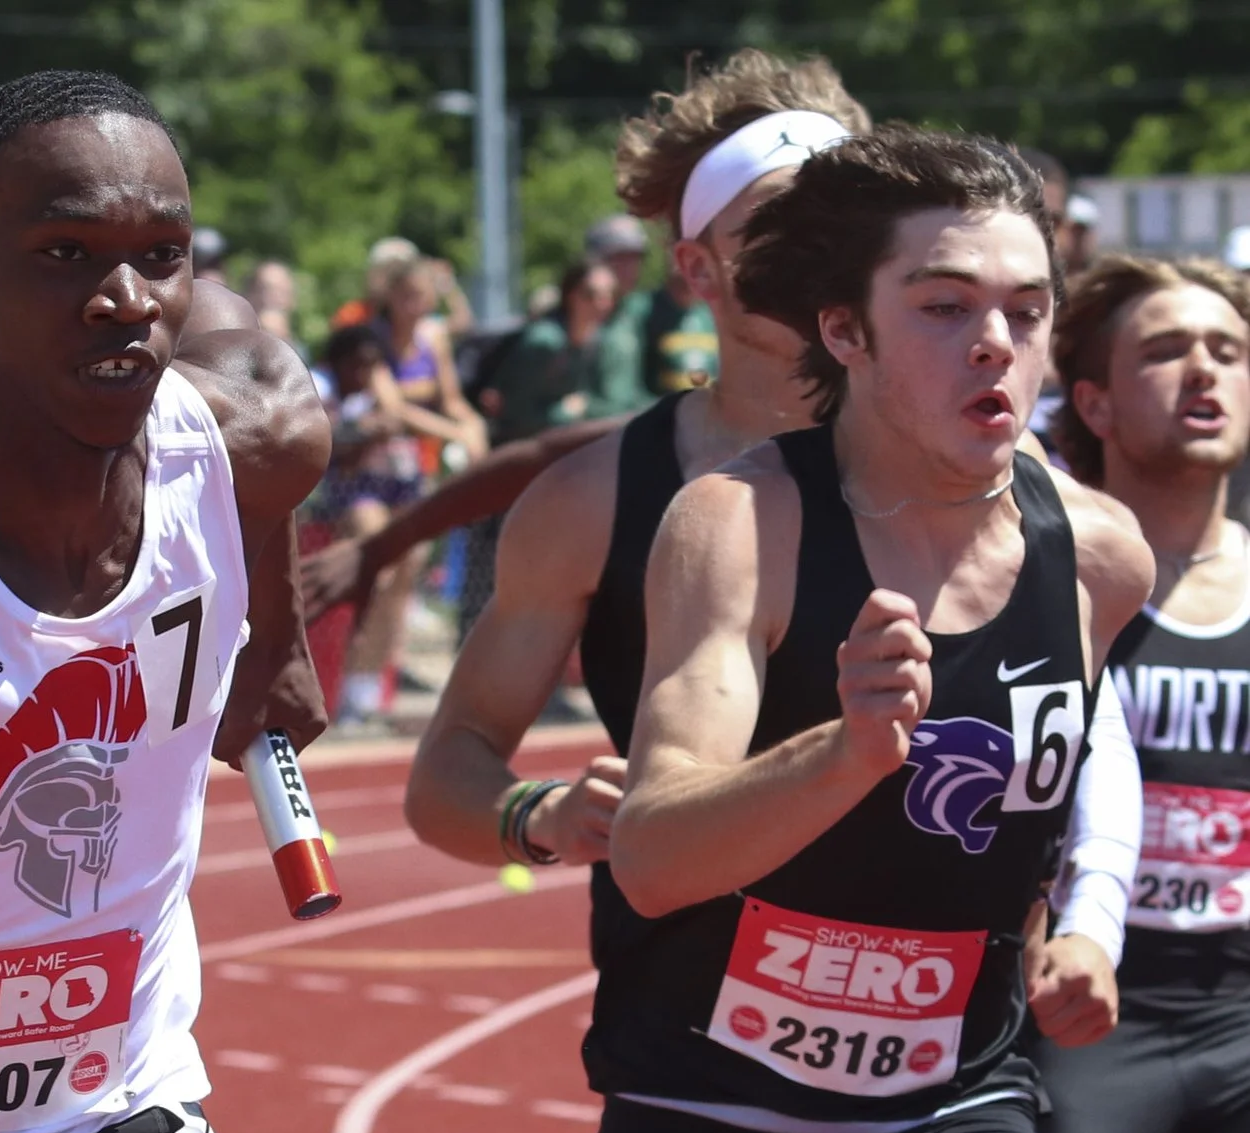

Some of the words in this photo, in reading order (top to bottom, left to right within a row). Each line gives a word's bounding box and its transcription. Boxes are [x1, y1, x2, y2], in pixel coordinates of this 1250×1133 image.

[151, 595, 203, 731] 7
[1025, 690, 1068, 803] 6
[1113, 664, 1250, 753] NORT
[1142, 803, 1243, 857] ERO
[755, 929, 955, 1007] ZERO
[815, 927, 923, 957] SHOW-ME
[769, 1016, 906, 1078] 2318
